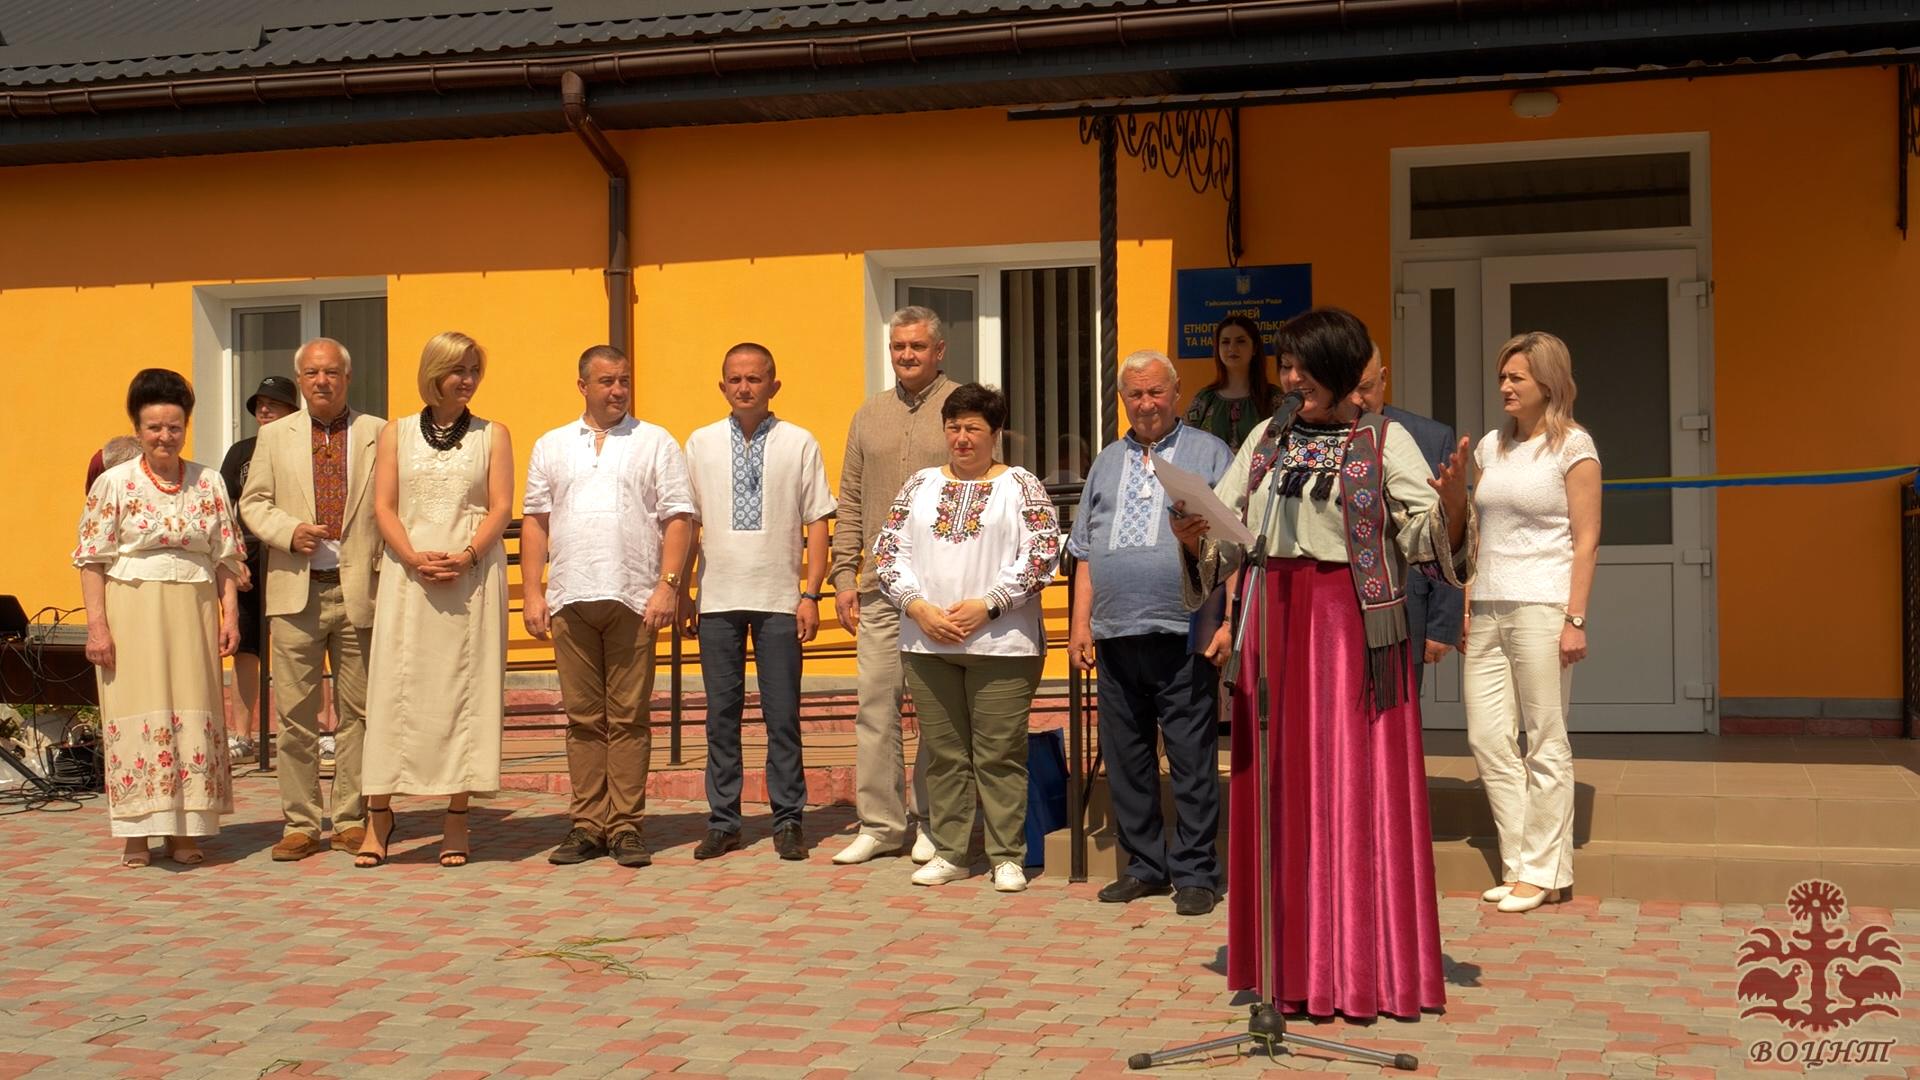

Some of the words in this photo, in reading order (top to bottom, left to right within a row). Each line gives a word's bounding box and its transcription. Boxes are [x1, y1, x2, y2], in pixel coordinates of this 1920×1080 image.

[1227, 307, 1260, 319] МУЗЕЙ
[1184, 322, 1219, 334] ЕТНОГР
[1185, 336, 1197, 347] ТА
